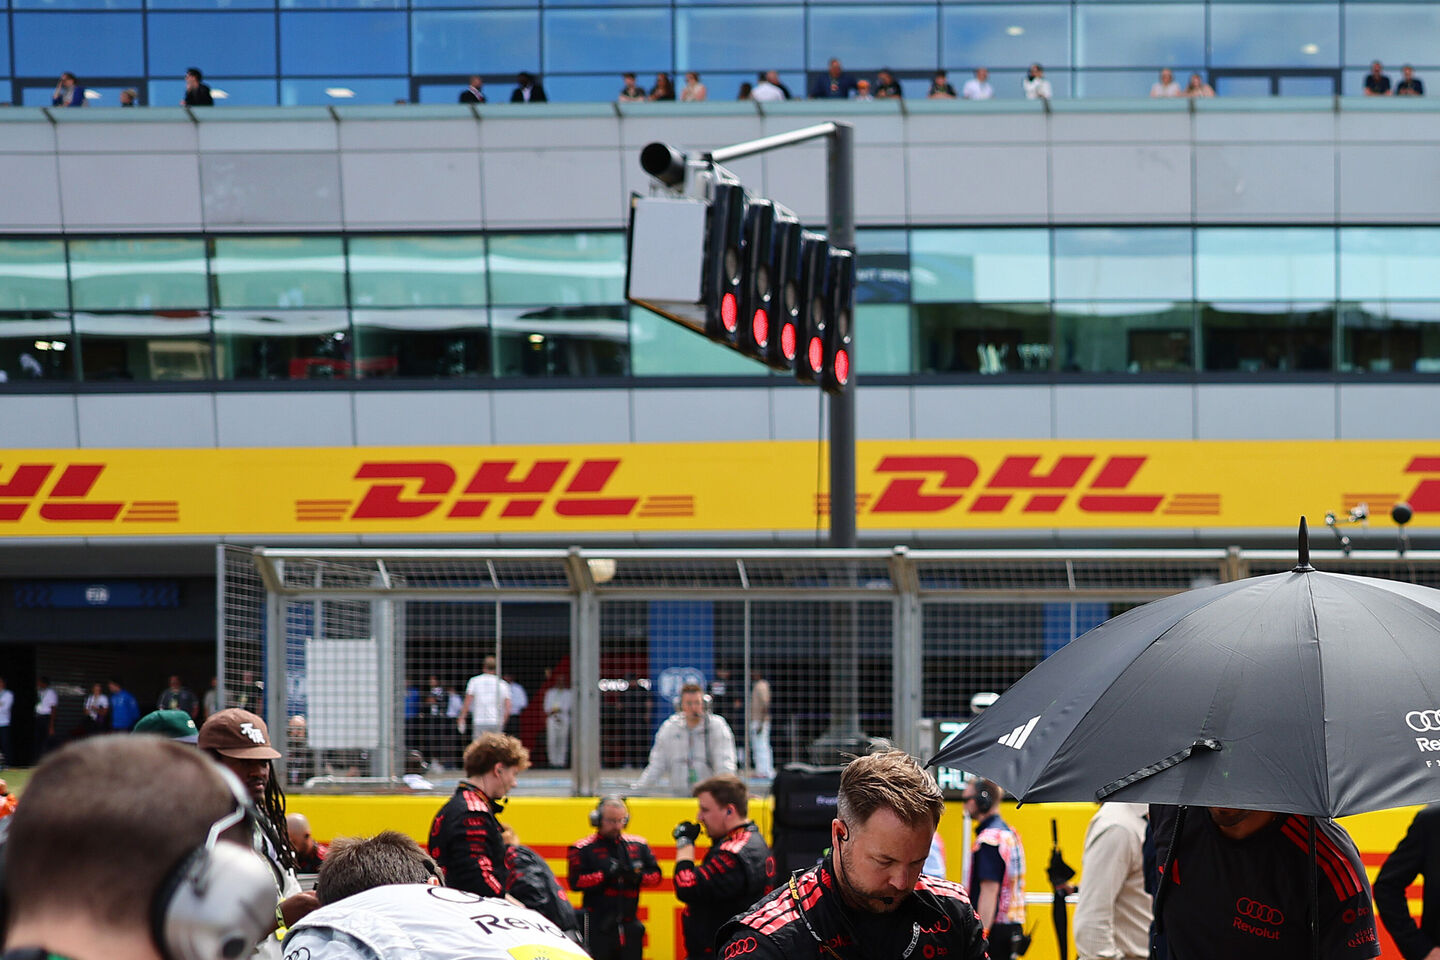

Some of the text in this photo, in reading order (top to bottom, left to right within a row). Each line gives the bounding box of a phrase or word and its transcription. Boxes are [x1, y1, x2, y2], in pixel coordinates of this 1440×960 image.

[350, 460, 639, 519] DHL
[871, 455, 1164, 514] DHL
[1232, 916, 1281, 941] Revolut
